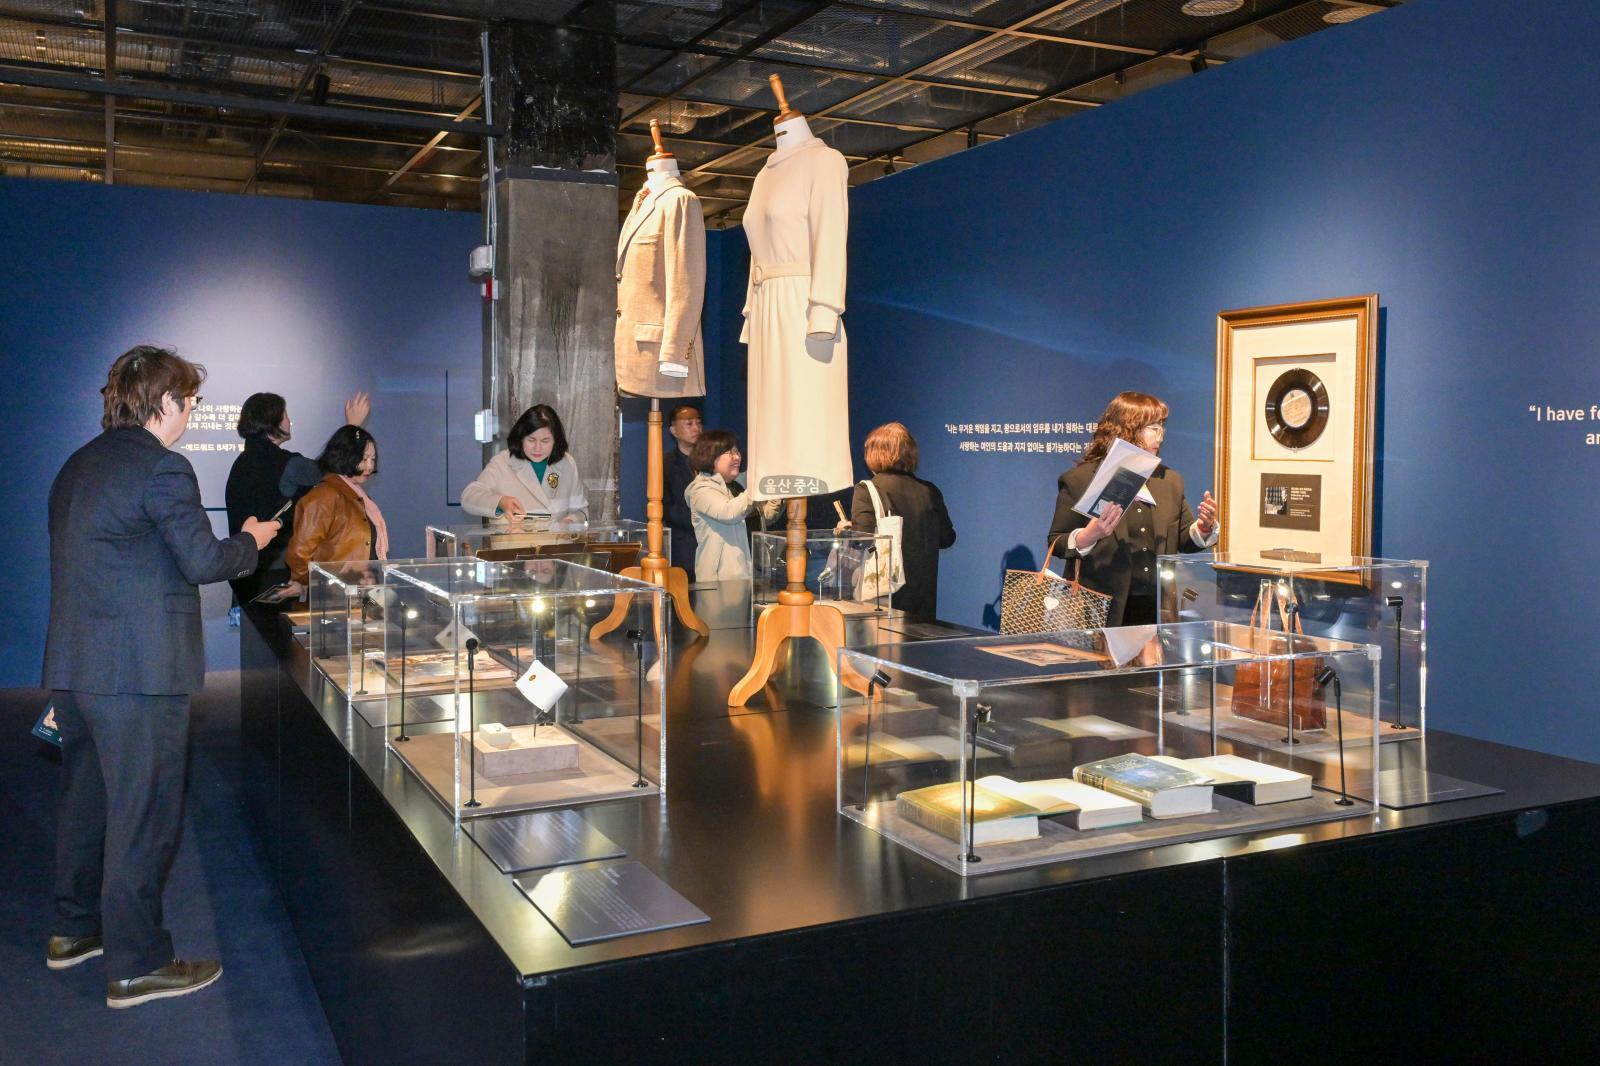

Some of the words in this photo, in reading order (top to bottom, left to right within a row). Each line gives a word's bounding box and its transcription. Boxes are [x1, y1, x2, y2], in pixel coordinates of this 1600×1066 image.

[218, 413, 226, 422] 더
[1546, 406, 1585, 421] have
[958, 423, 974, 434] 무거운
[1051, 422, 1065, 434] 내가
[1065, 422, 1085, 434] 원하는
[997, 441, 1014, 452] 도움과
[1014, 441, 1026, 452] 지지
[1026, 441, 1045, 453] 없이는
[1046, 441, 1082, 453] 불가능하다는
